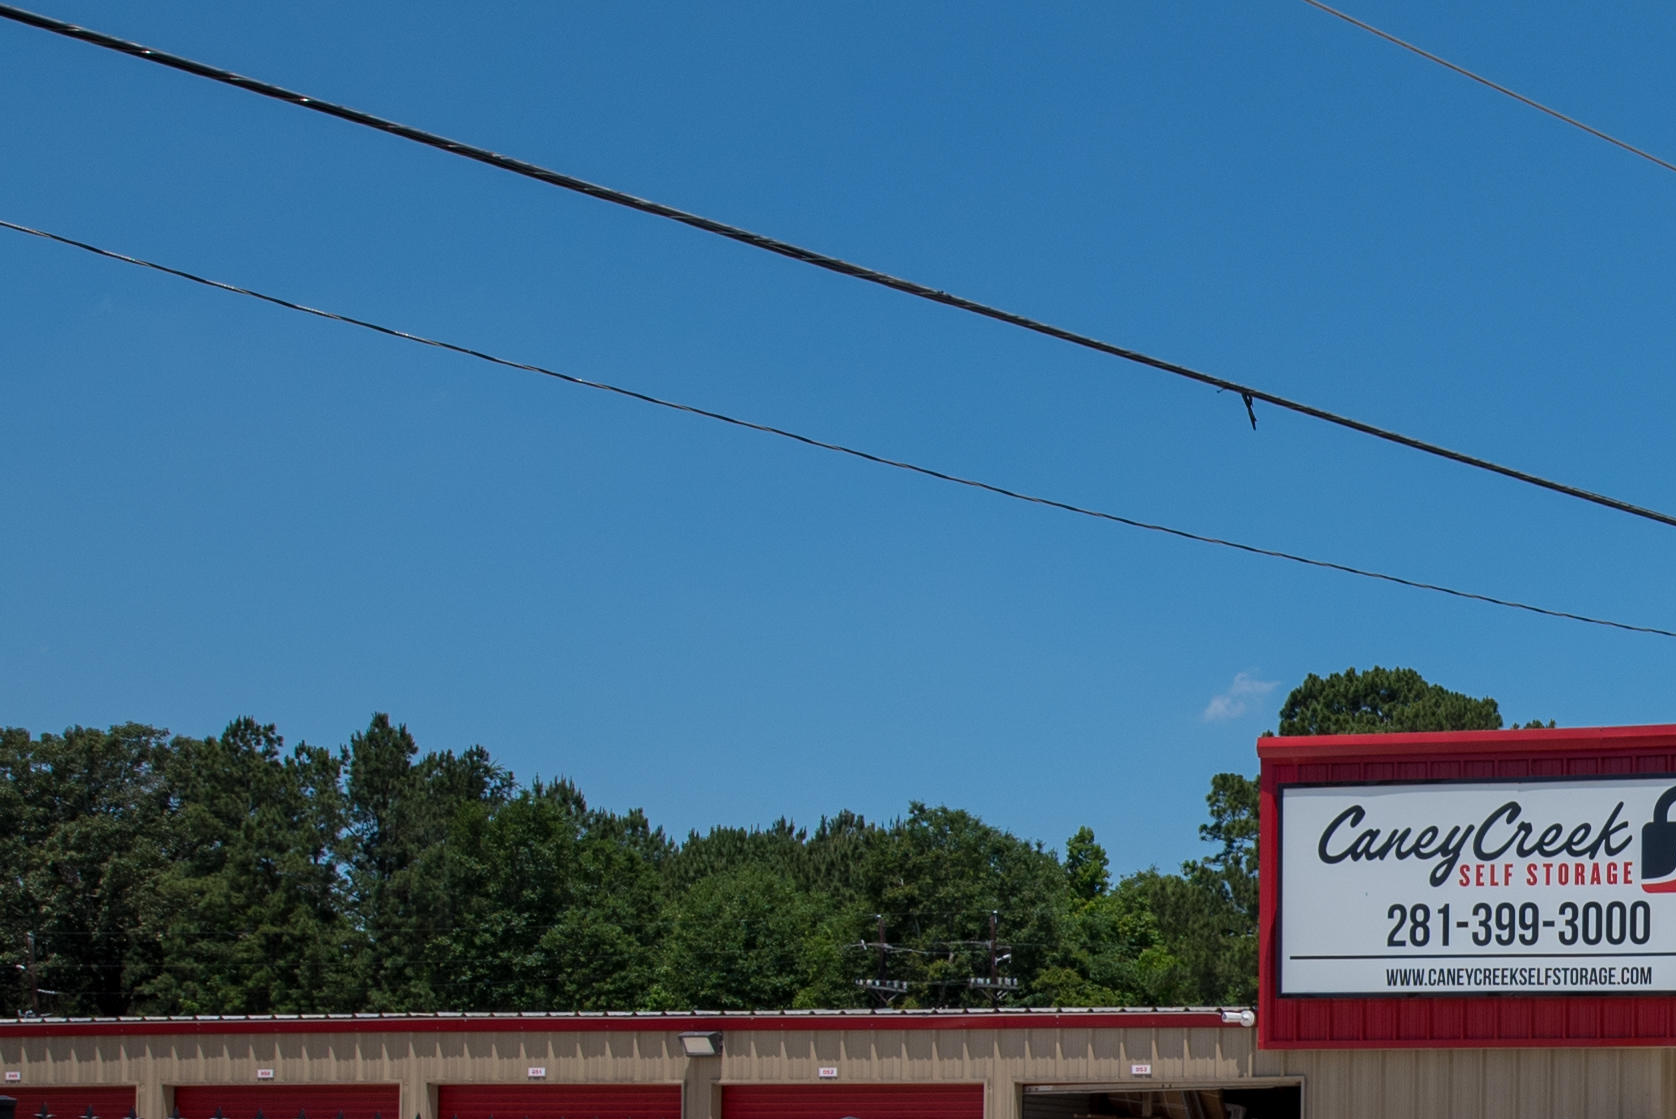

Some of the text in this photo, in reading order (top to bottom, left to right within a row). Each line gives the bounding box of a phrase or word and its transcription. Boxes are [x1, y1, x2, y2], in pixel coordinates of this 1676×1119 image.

[1459, 861, 1633, 887] SELF STORAGE
[1386, 900, 1651, 948] 281-399-3000
[1386, 966, 1653, 987] WWW.CANEYCREEKSELFSTORAGE.COM
